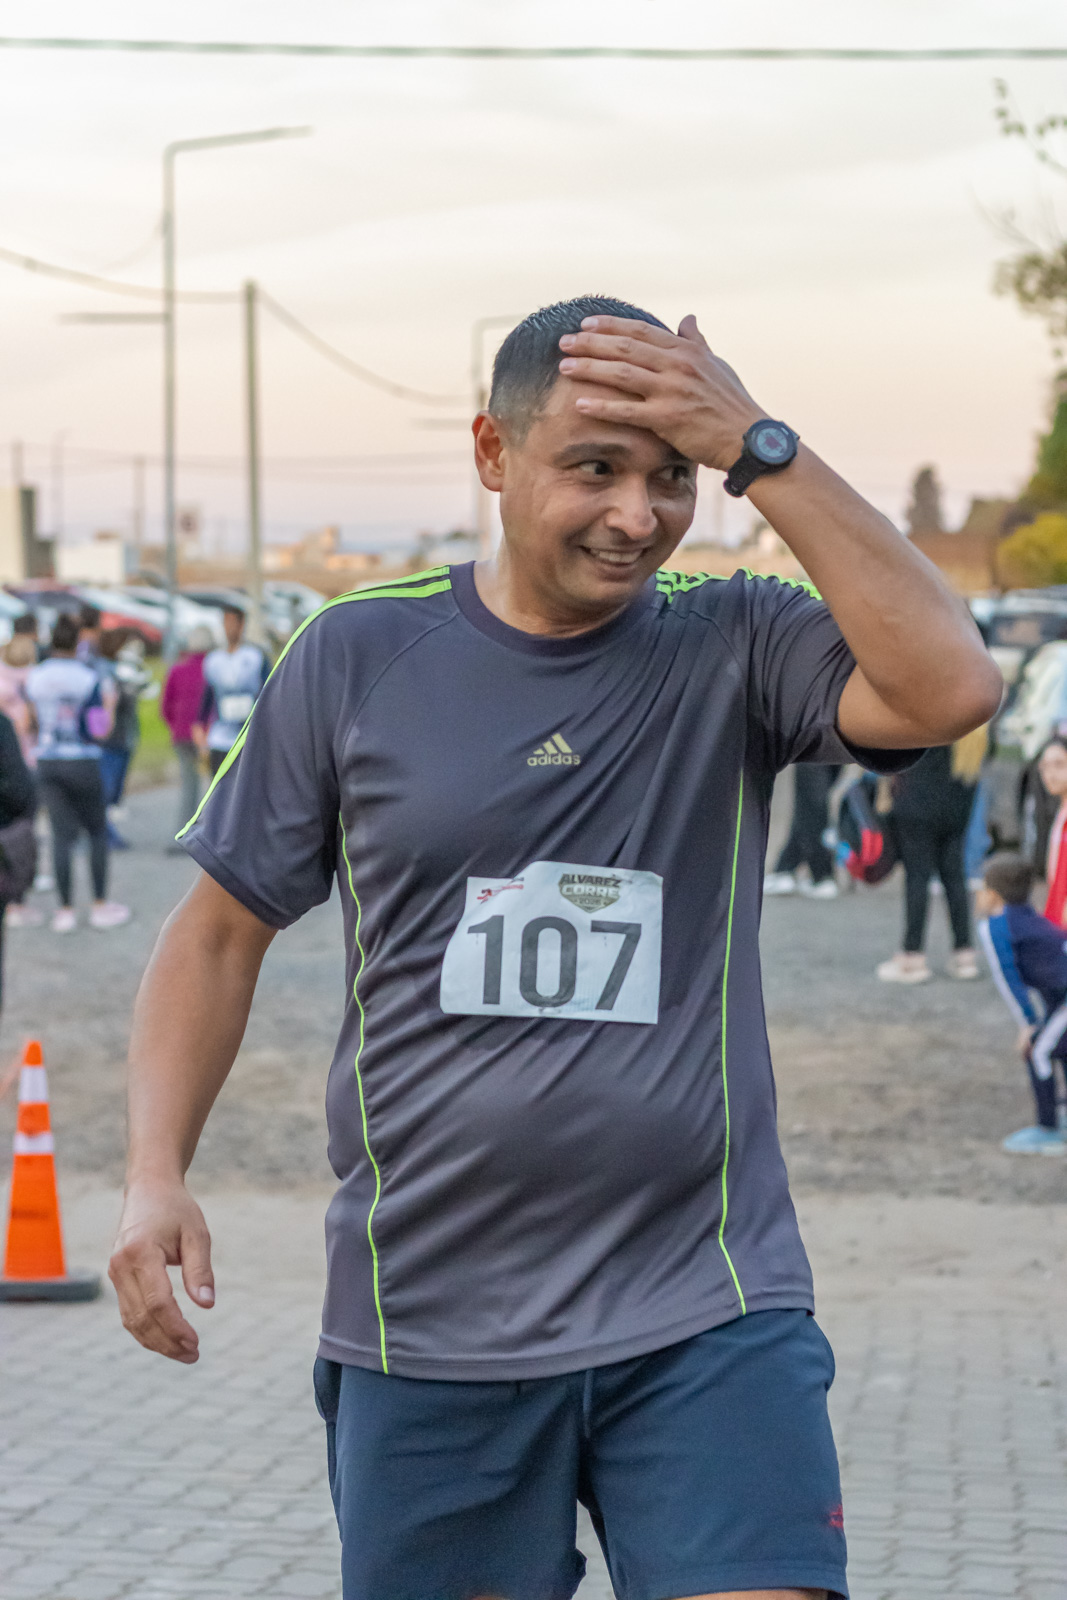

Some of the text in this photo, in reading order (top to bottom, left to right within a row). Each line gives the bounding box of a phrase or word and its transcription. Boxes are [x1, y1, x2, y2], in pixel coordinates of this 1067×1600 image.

[527, 753, 581, 767] adidas
[561, 873, 621, 888] ALVAREZ
[561, 884, 620, 899] CORRE
[467, 914, 642, 1011] 107
